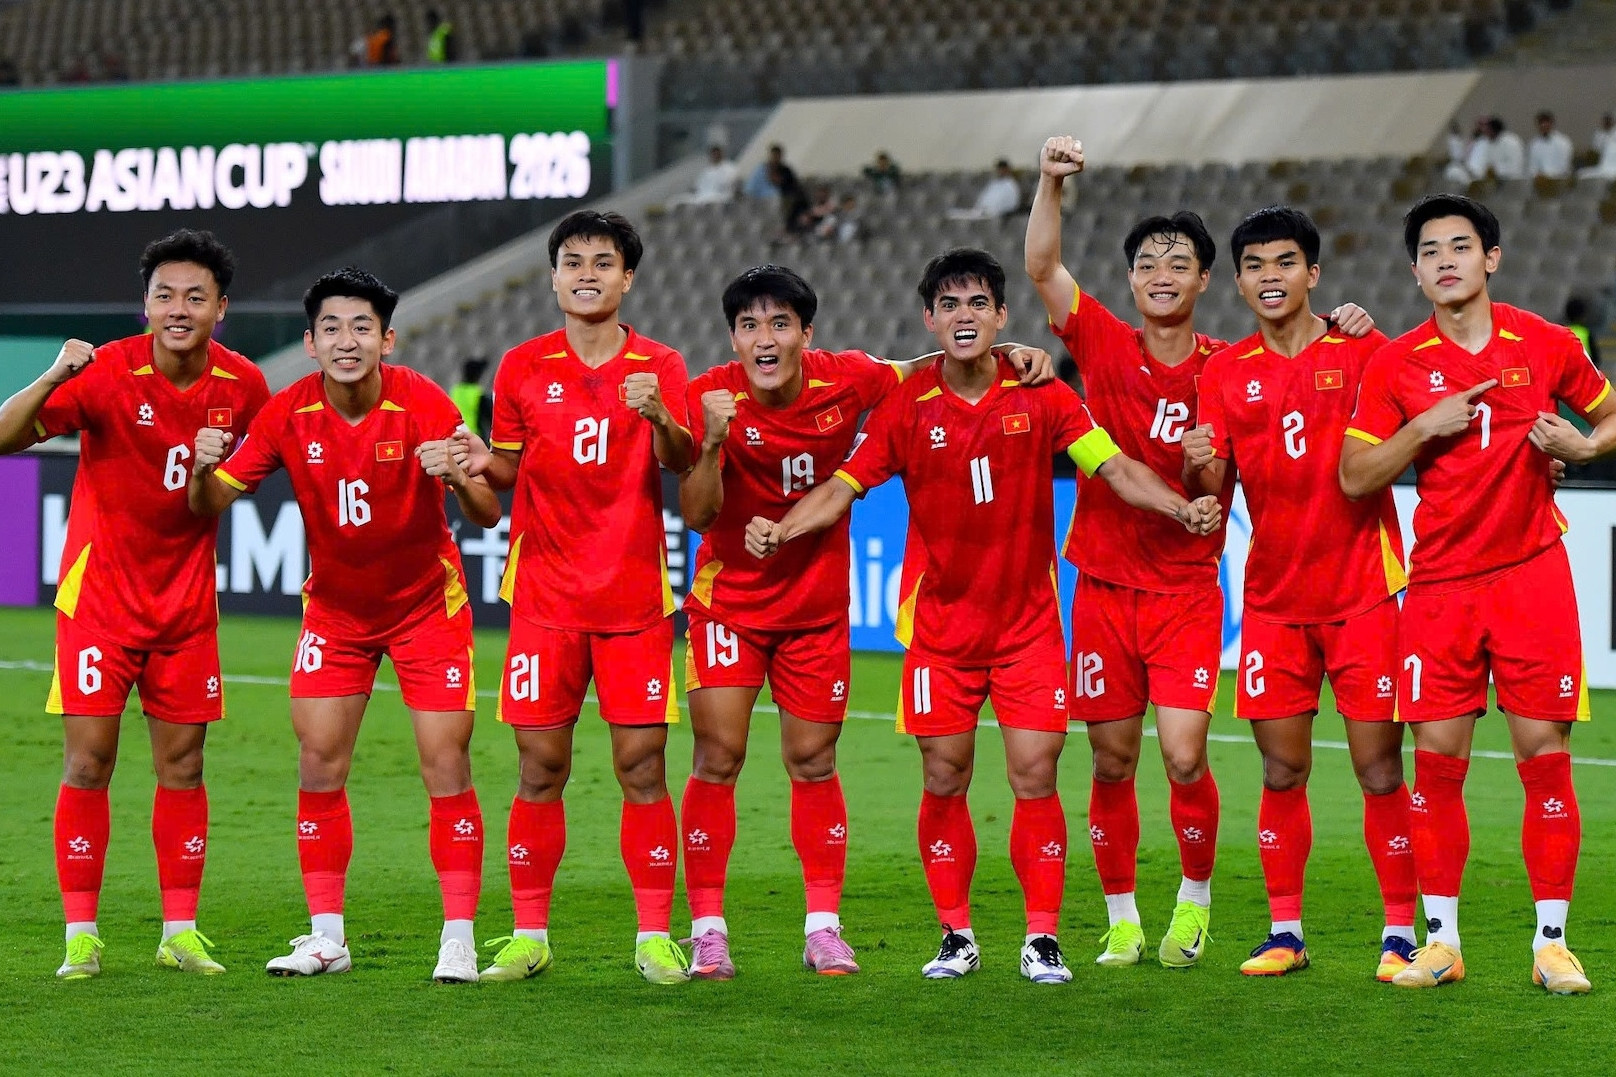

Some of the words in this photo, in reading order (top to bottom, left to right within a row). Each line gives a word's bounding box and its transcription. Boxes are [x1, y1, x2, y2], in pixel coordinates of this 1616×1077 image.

[8, 150, 87, 214] U23
[86, 147, 216, 212] ASIAN
[573, 417, 609, 465] 21
[1150, 398, 1188, 444] 12
[1283, 410, 1306, 459] 2
[1475, 402, 1491, 449] 7
[164, 444, 190, 491] 6
[782, 453, 814, 496] 19
[970, 456, 993, 504] 11
[339, 479, 371, 526] 16
[294, 629, 326, 673] 16
[706, 621, 738, 668] 19
[78, 646, 102, 695] 6
[510, 653, 539, 702] 21
[914, 667, 931, 714] 11
[1076, 652, 1104, 698] 12
[1246, 650, 1265, 697] 2
[1404, 654, 1422, 702] 7
